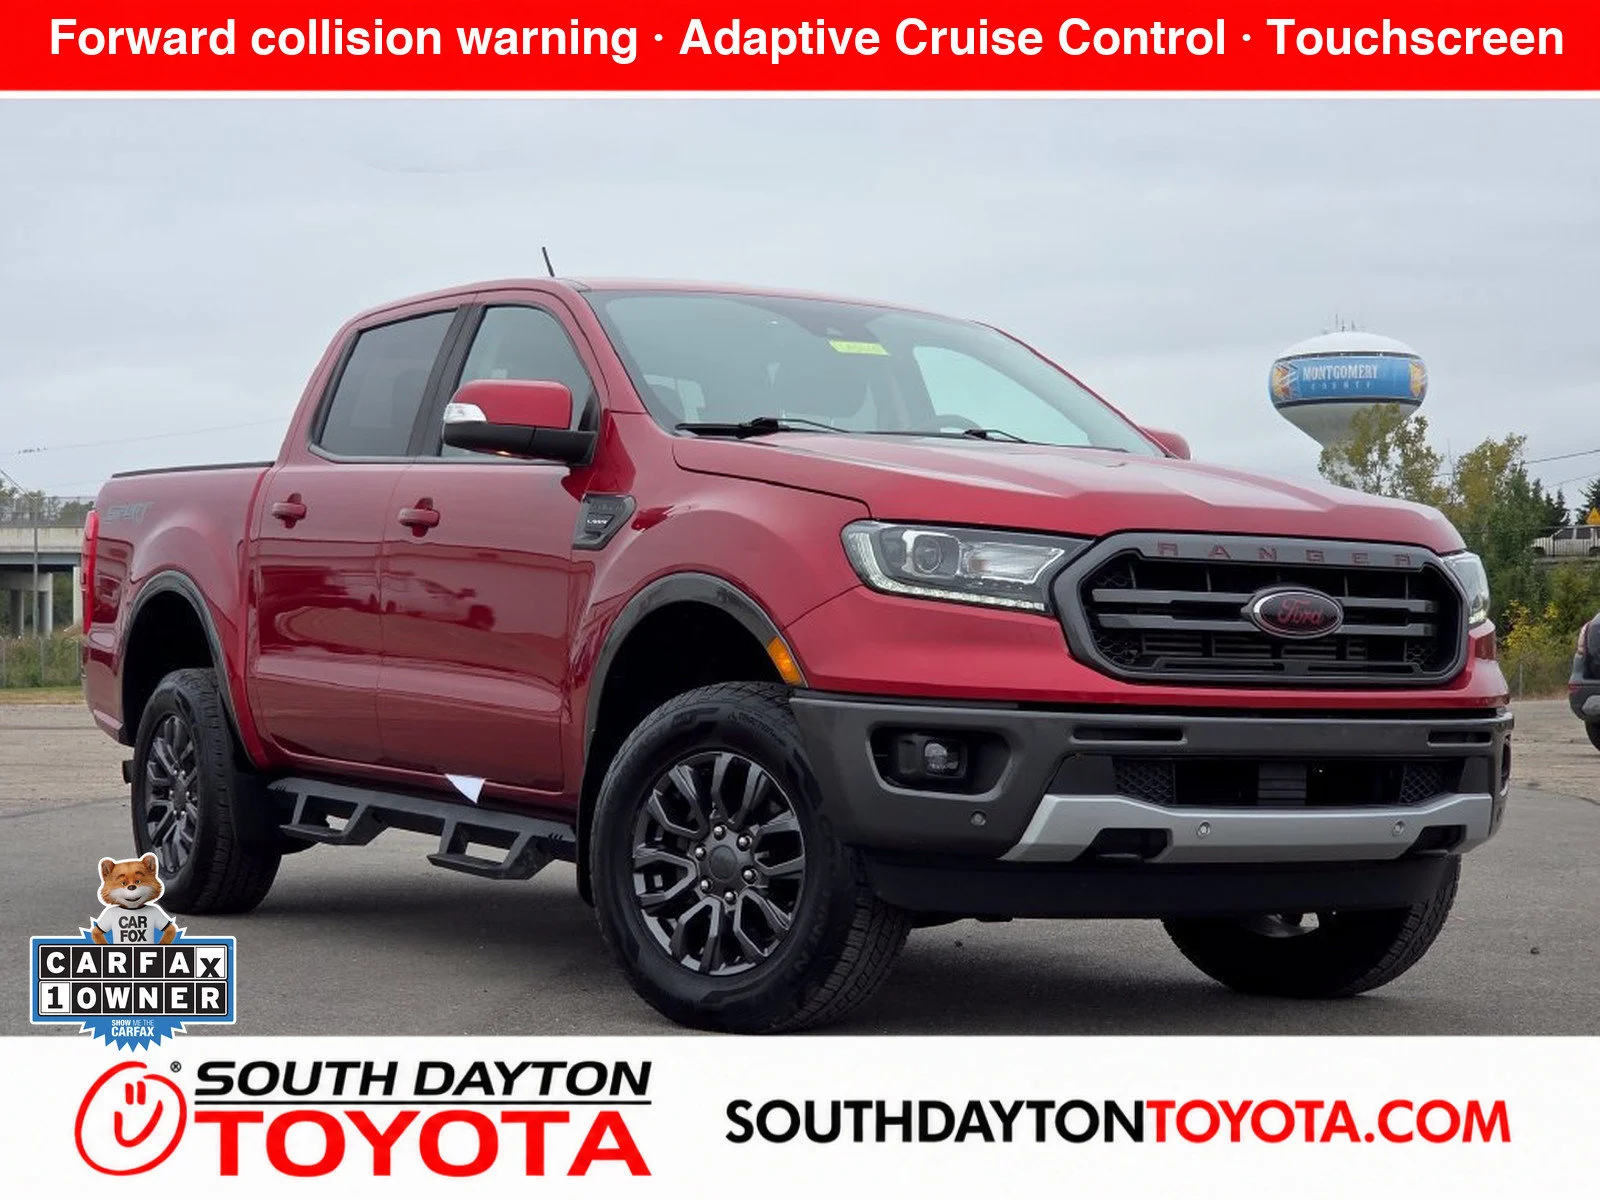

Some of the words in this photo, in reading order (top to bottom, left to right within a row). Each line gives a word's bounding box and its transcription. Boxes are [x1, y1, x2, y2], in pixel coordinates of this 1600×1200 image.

[1302, 364, 1378, 381] MONTGOMERY
[1157, 541, 1412, 566] RANGER
[1276, 598, 1324, 626] Ford
